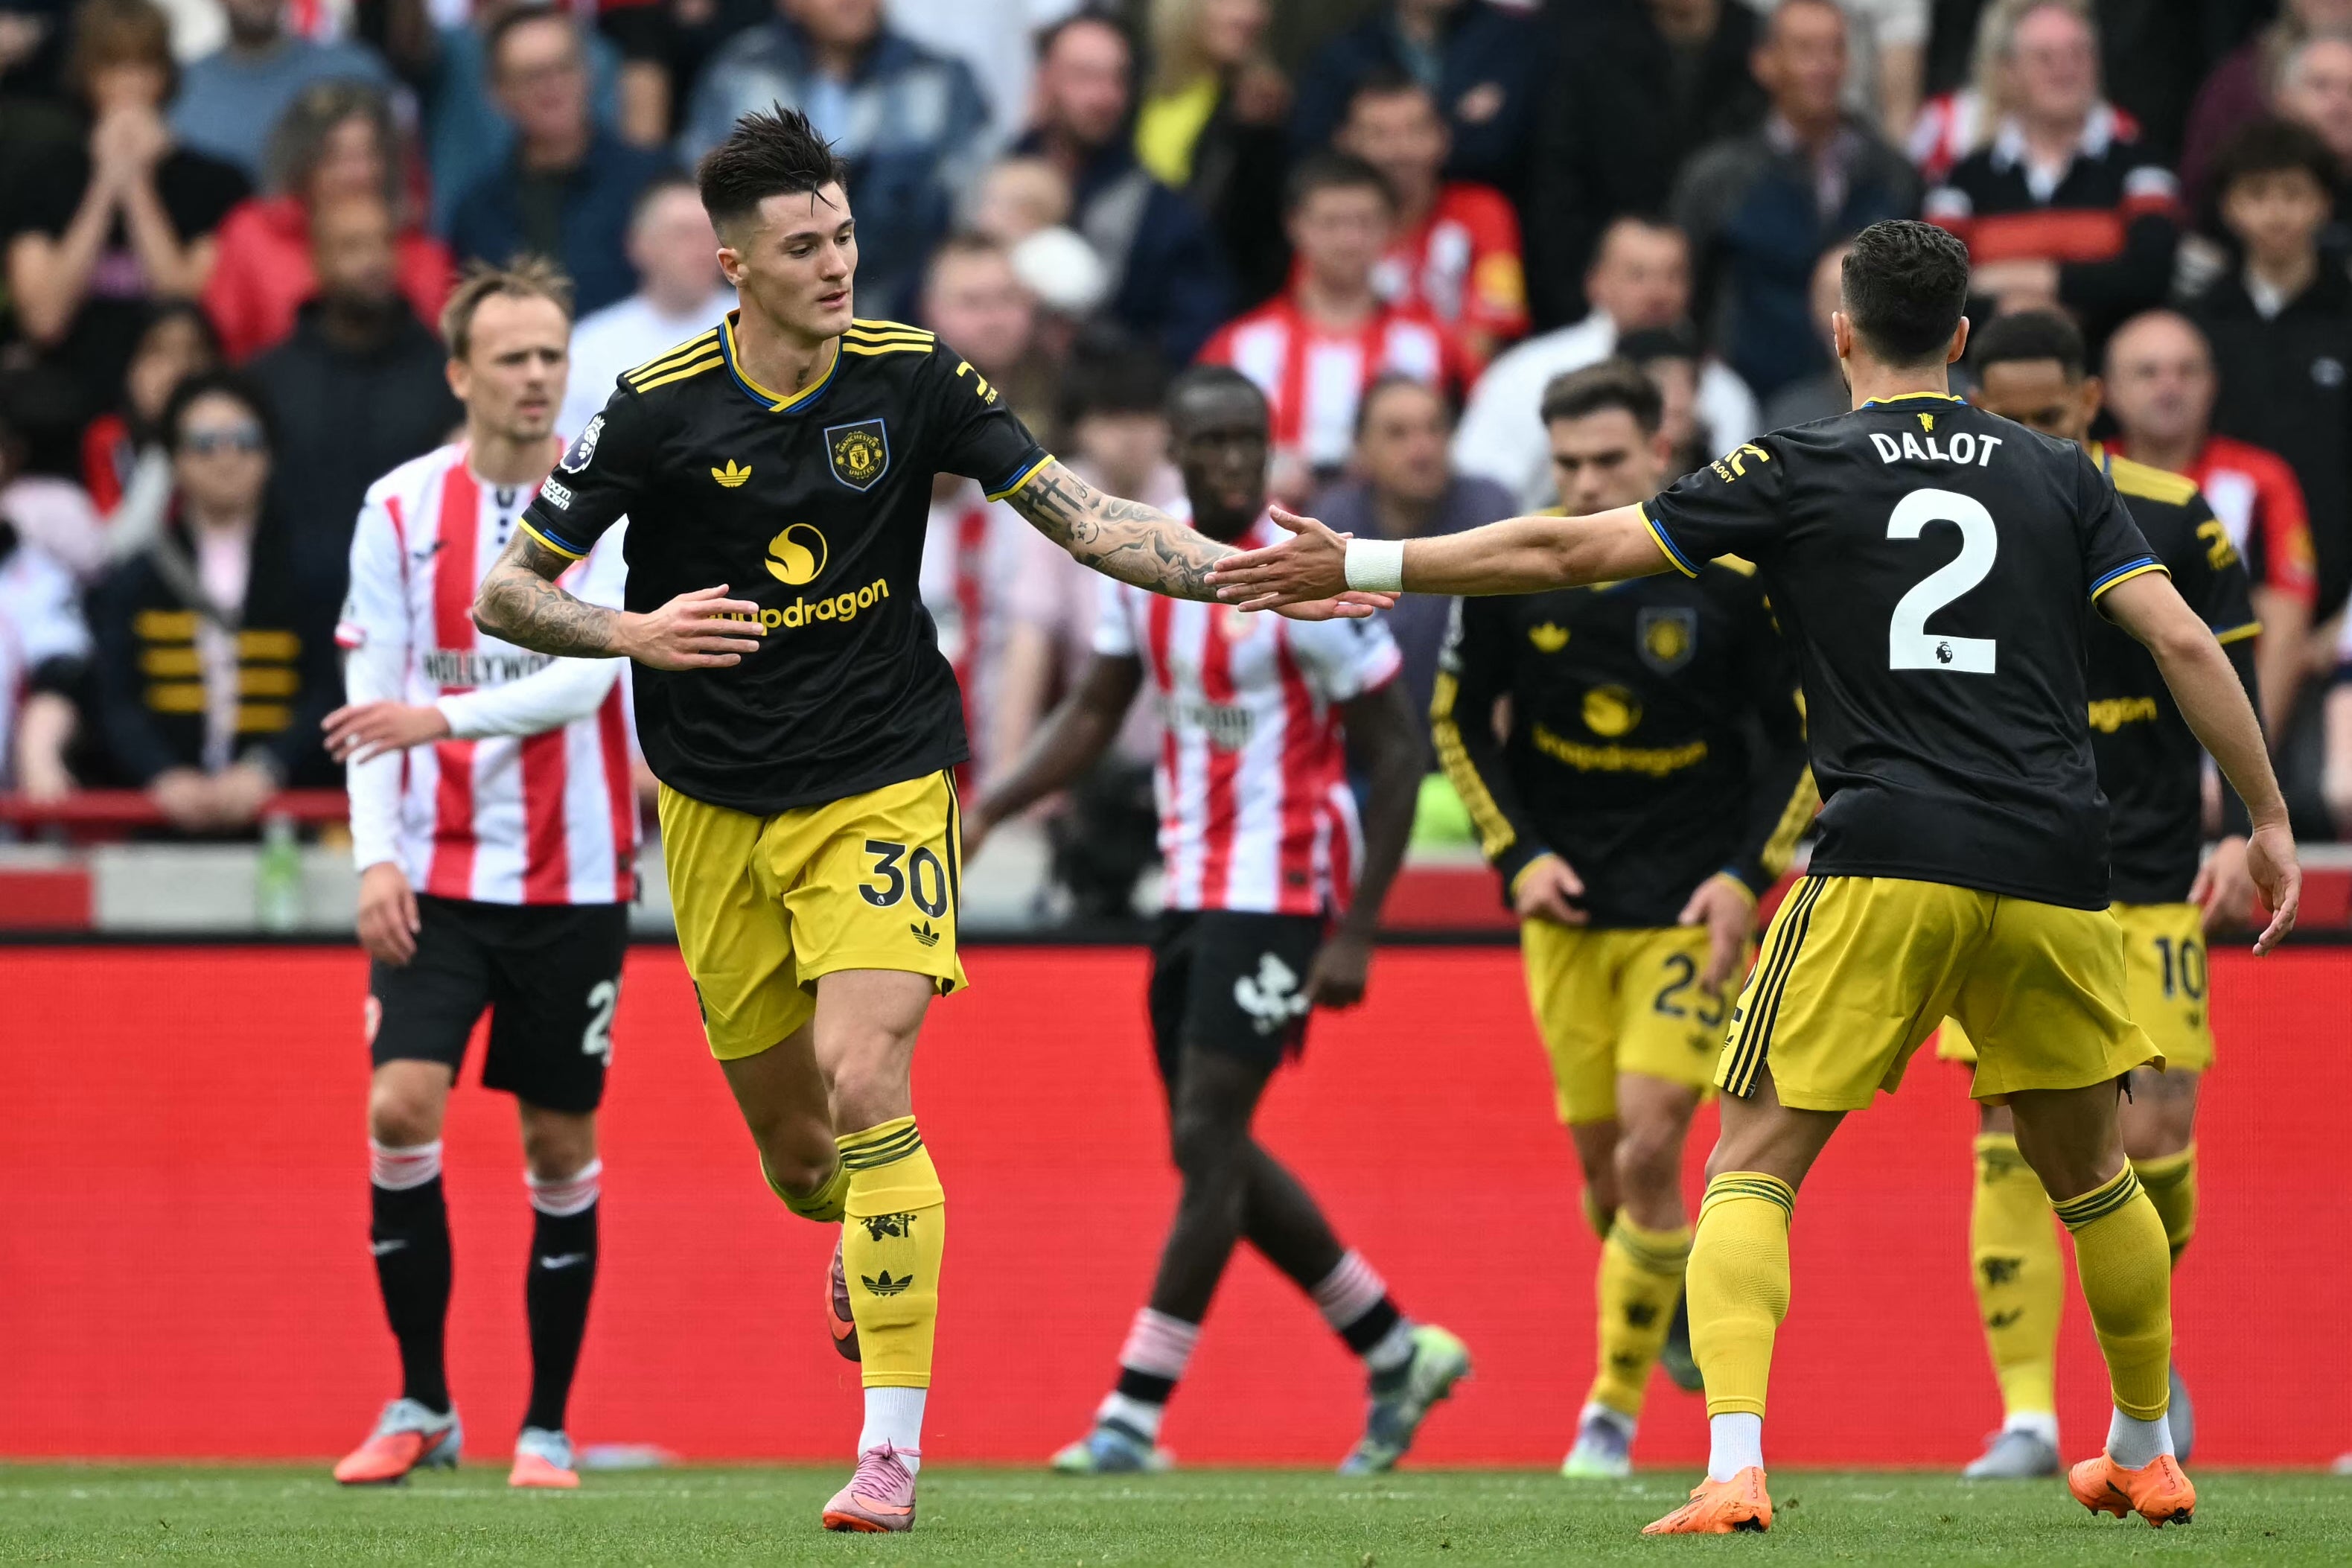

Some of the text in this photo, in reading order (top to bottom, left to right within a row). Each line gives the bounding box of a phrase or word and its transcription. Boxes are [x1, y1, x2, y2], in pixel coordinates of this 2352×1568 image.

[838, 434, 876, 453] MANCHESTER
[1869, 432, 2003, 467] DALOT
[849, 465, 875, 475] UNITED
[1885, 488, 1998, 674] 2
[858, 839, 949, 919] 30
[2154, 936, 2205, 1001] 10
